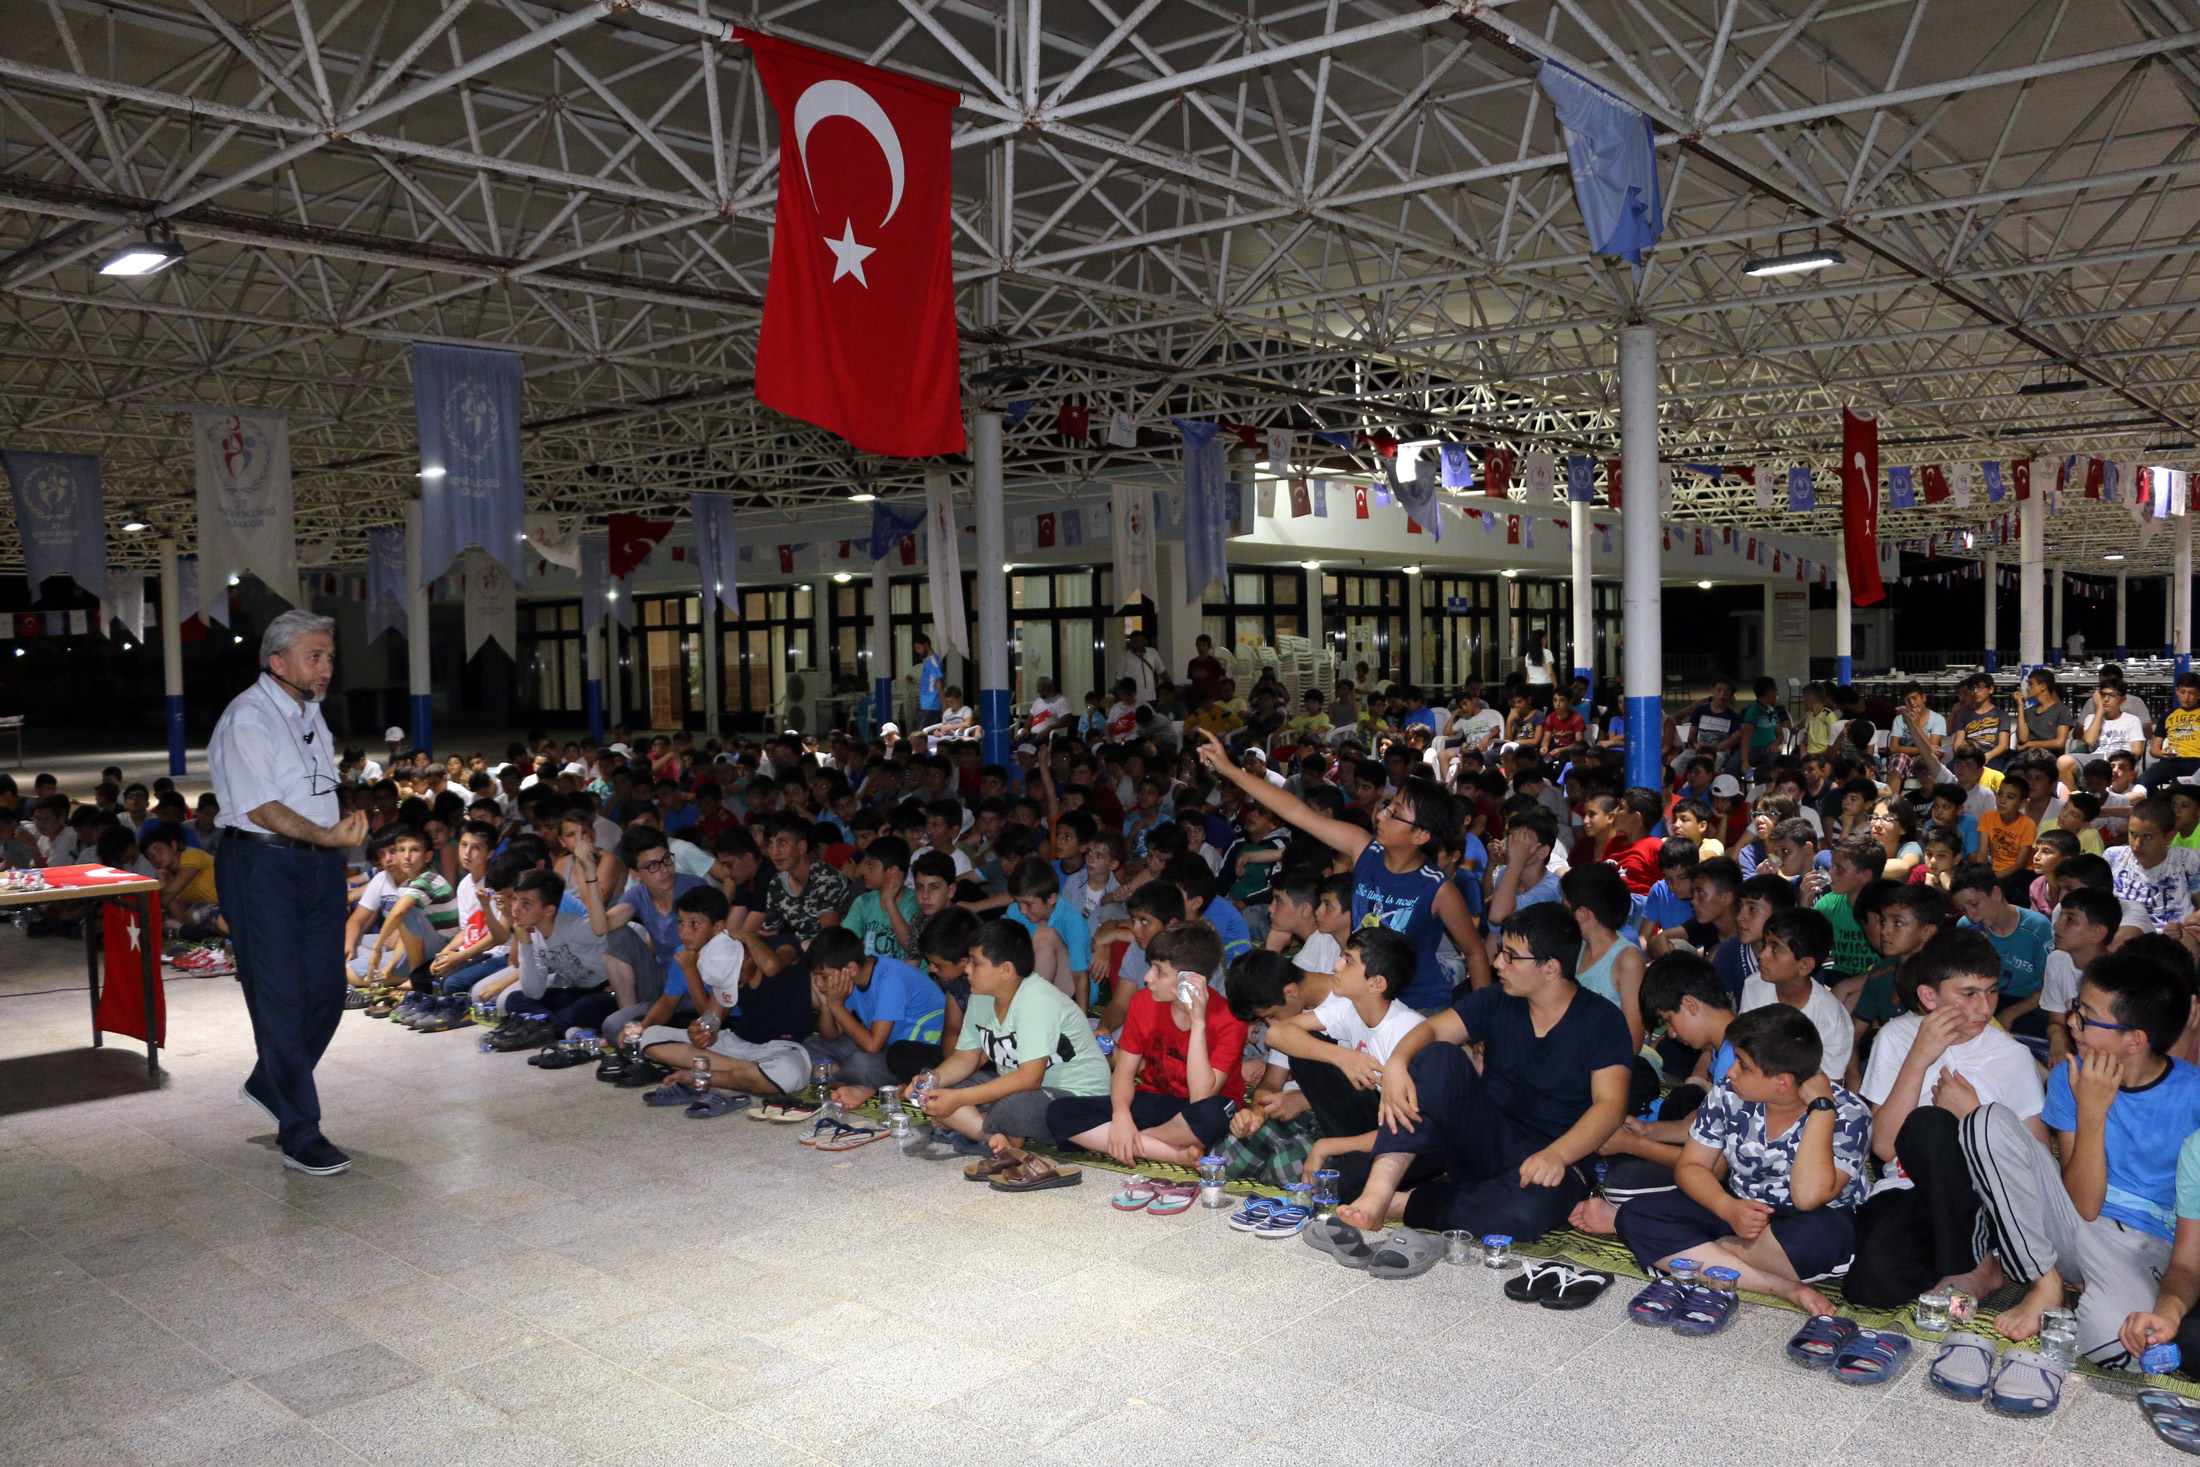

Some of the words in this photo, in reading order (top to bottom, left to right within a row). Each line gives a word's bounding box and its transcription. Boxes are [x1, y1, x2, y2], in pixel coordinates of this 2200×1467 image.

[1366, 889, 1385, 903] time
[1385, 893, 1395, 905] is
[1395, 895, 1420, 907] now!
